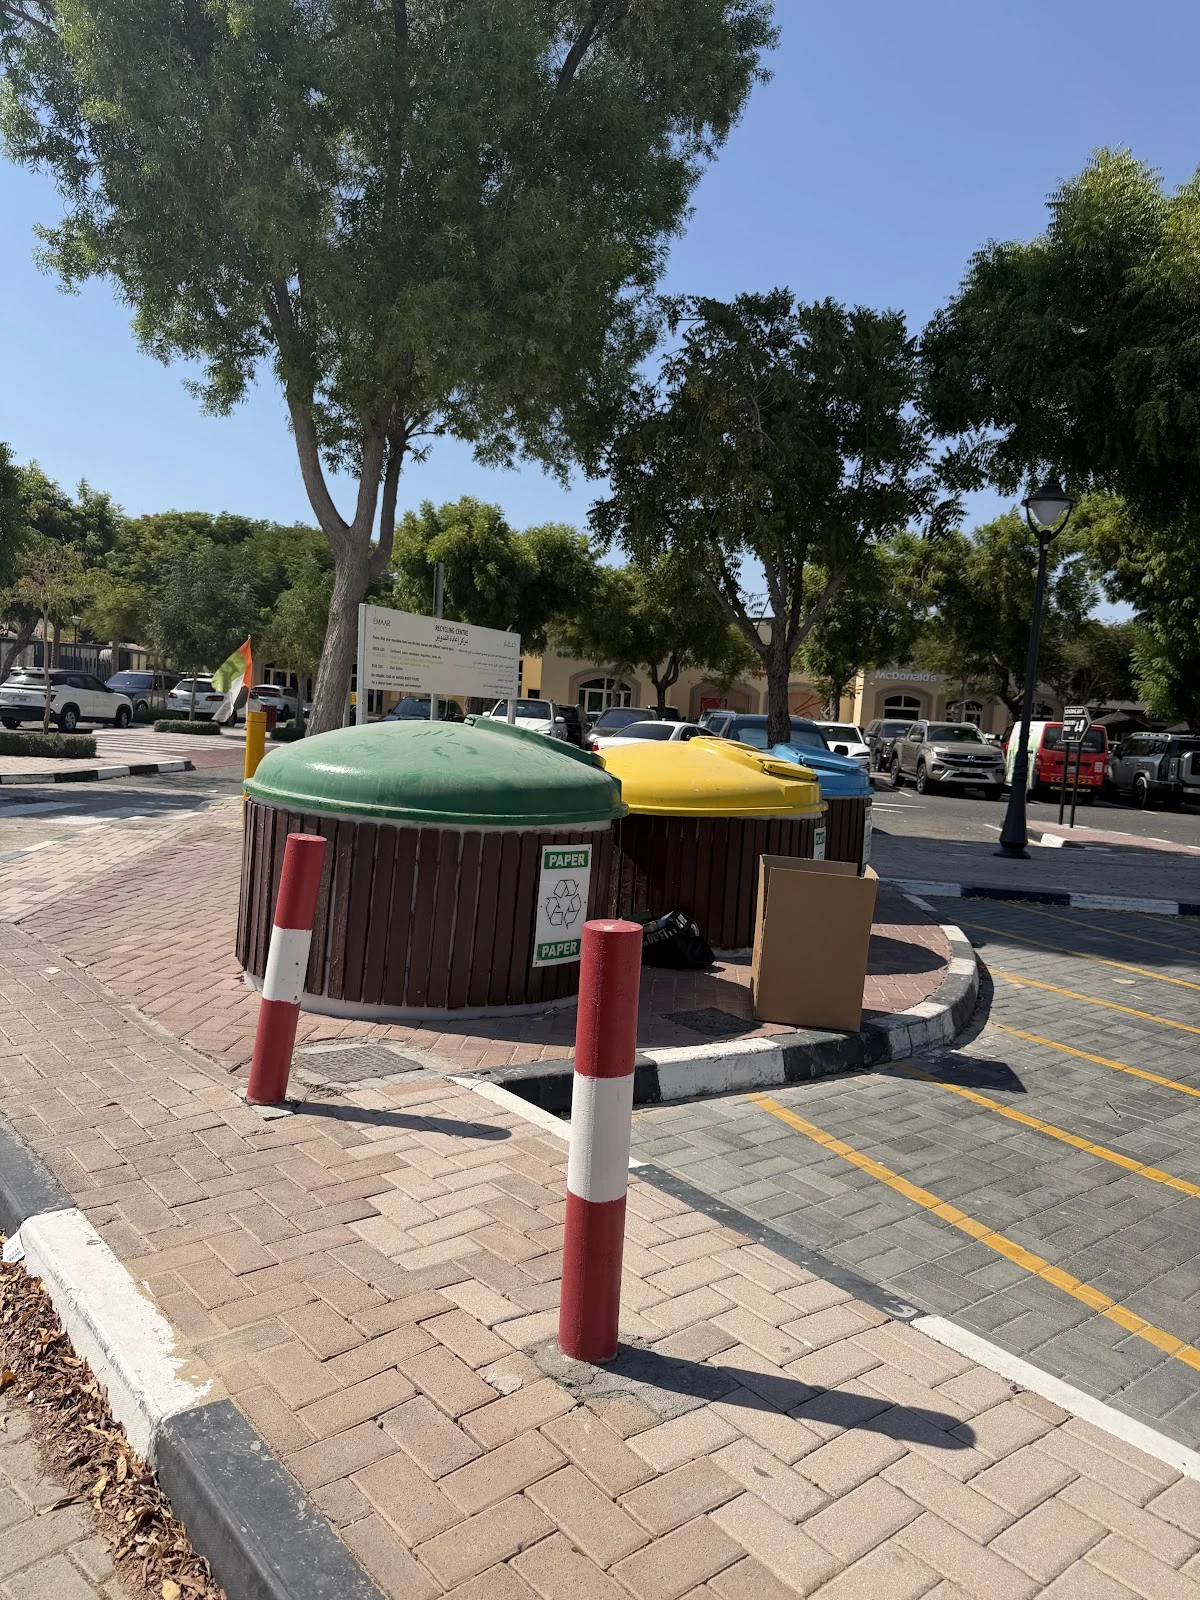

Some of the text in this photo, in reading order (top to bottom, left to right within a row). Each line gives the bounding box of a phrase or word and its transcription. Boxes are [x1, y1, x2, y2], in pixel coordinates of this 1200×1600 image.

[435, 624, 469, 637] RECYCLING CENTRE
[549, 853, 585, 867] PAPER
[541, 941, 577, 958] PAPER
